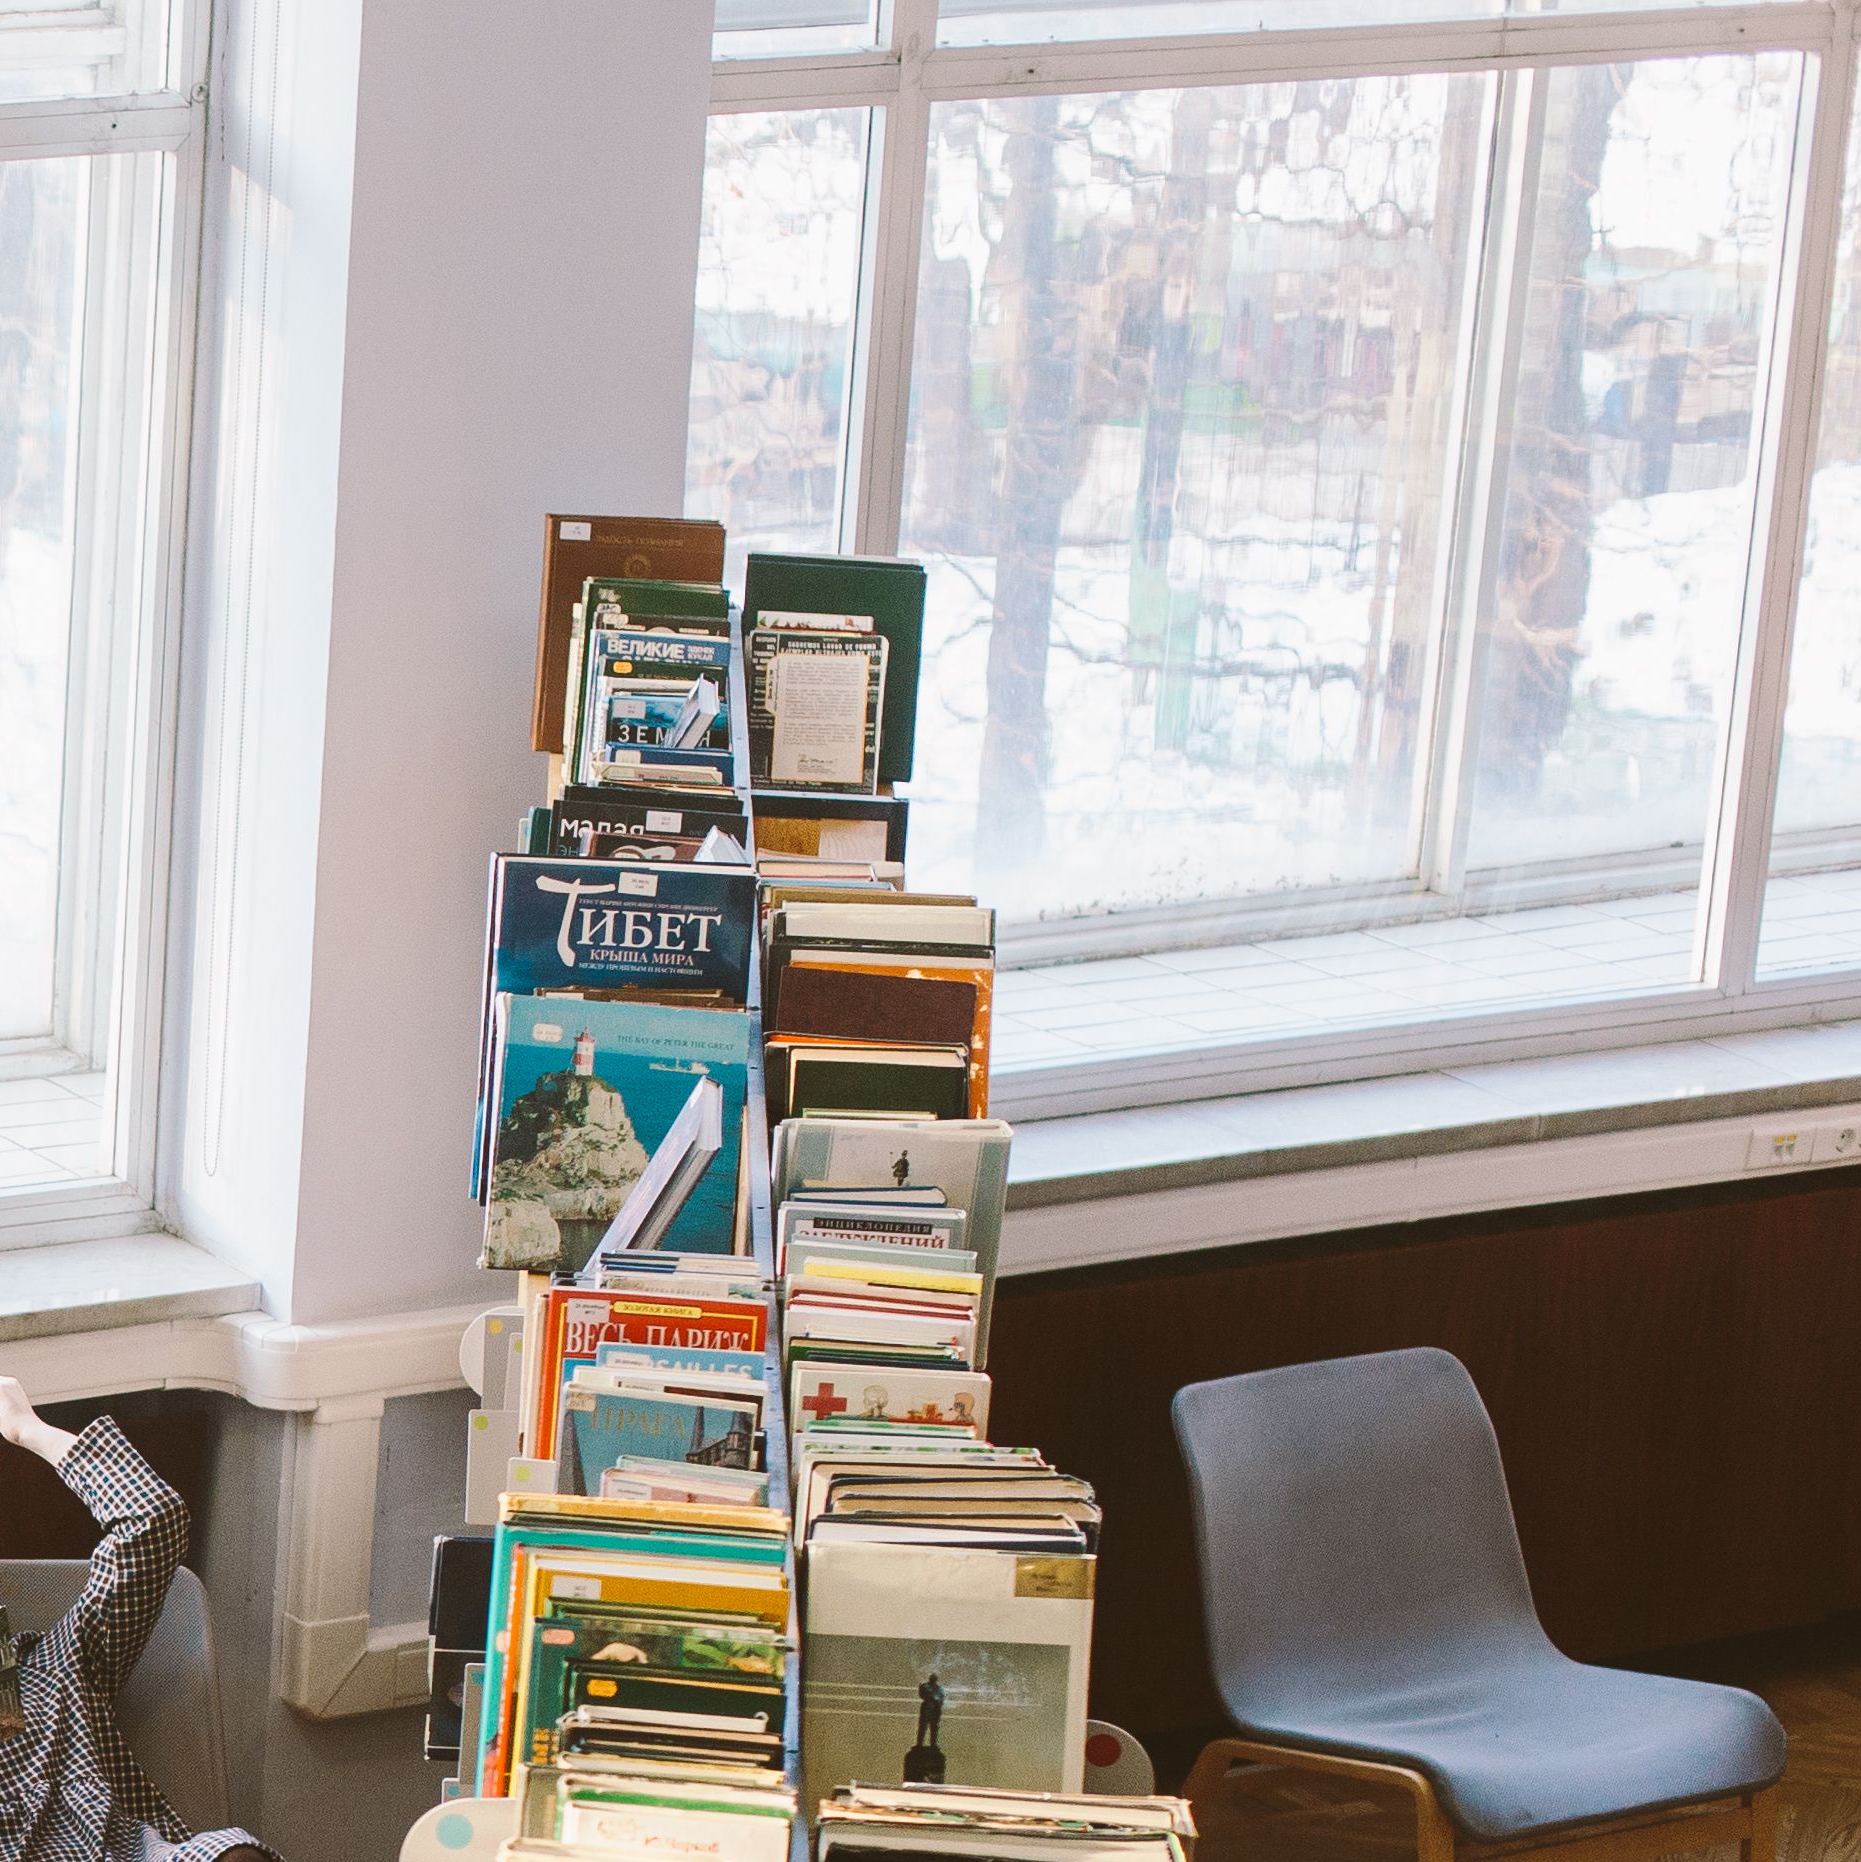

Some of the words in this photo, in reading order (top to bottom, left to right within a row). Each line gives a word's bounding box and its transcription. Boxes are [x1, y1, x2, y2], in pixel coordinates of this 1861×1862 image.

[607, 639, 685, 660] ВЕЛИКИЕ
[535, 875, 722, 968] ТИБЕТ
[590, 949, 648, 963] КРЫША
[651, 952, 694, 966] МИРА
[816, 1218, 932, 1234] ЭНЦИКЛОПЕДИЯ
[645, 1325, 750, 1352] ПАРИЖ
